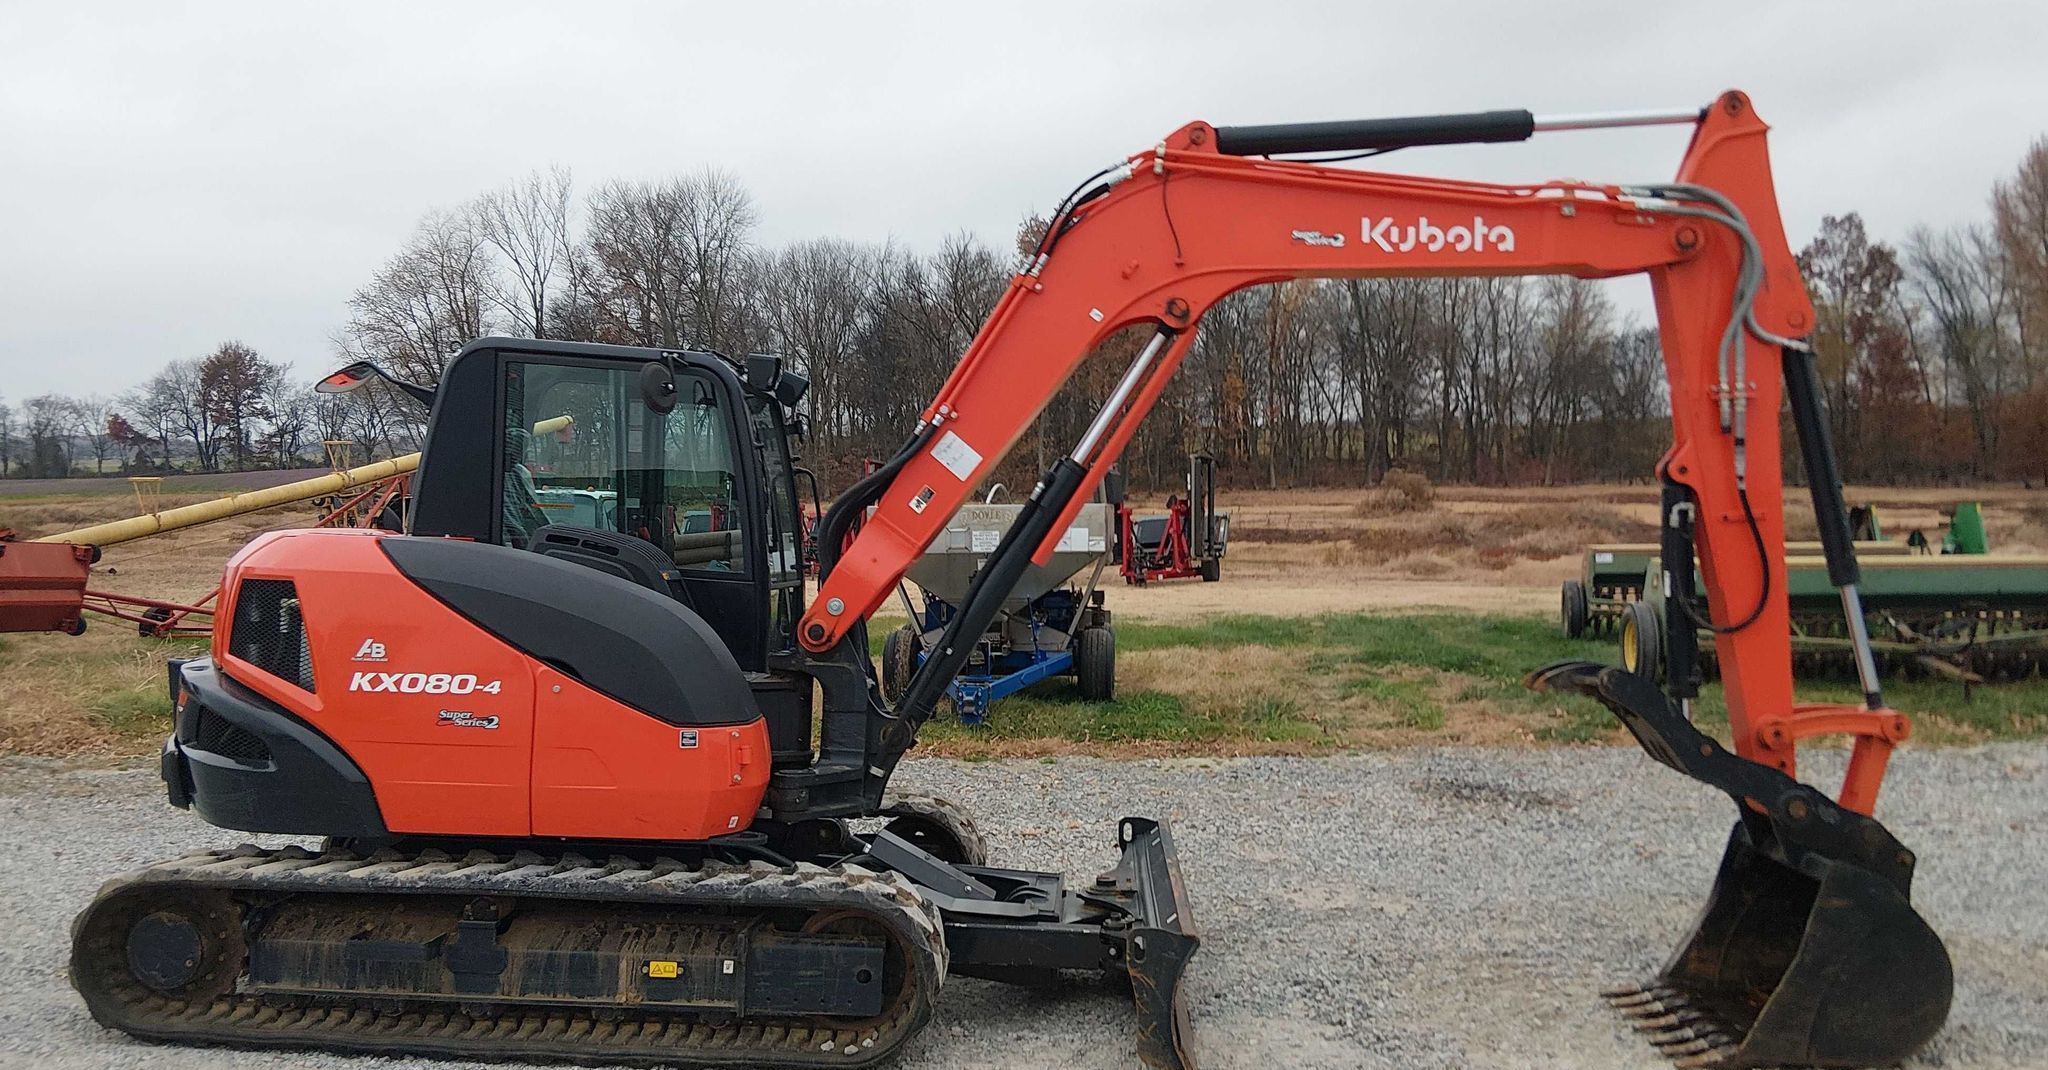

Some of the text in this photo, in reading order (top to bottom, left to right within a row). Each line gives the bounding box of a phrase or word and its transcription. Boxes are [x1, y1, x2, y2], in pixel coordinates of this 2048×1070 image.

[1361, 216, 1515, 253] Kubota
[349, 672, 502, 695] KX080-4
[439, 709, 473, 720] Super
